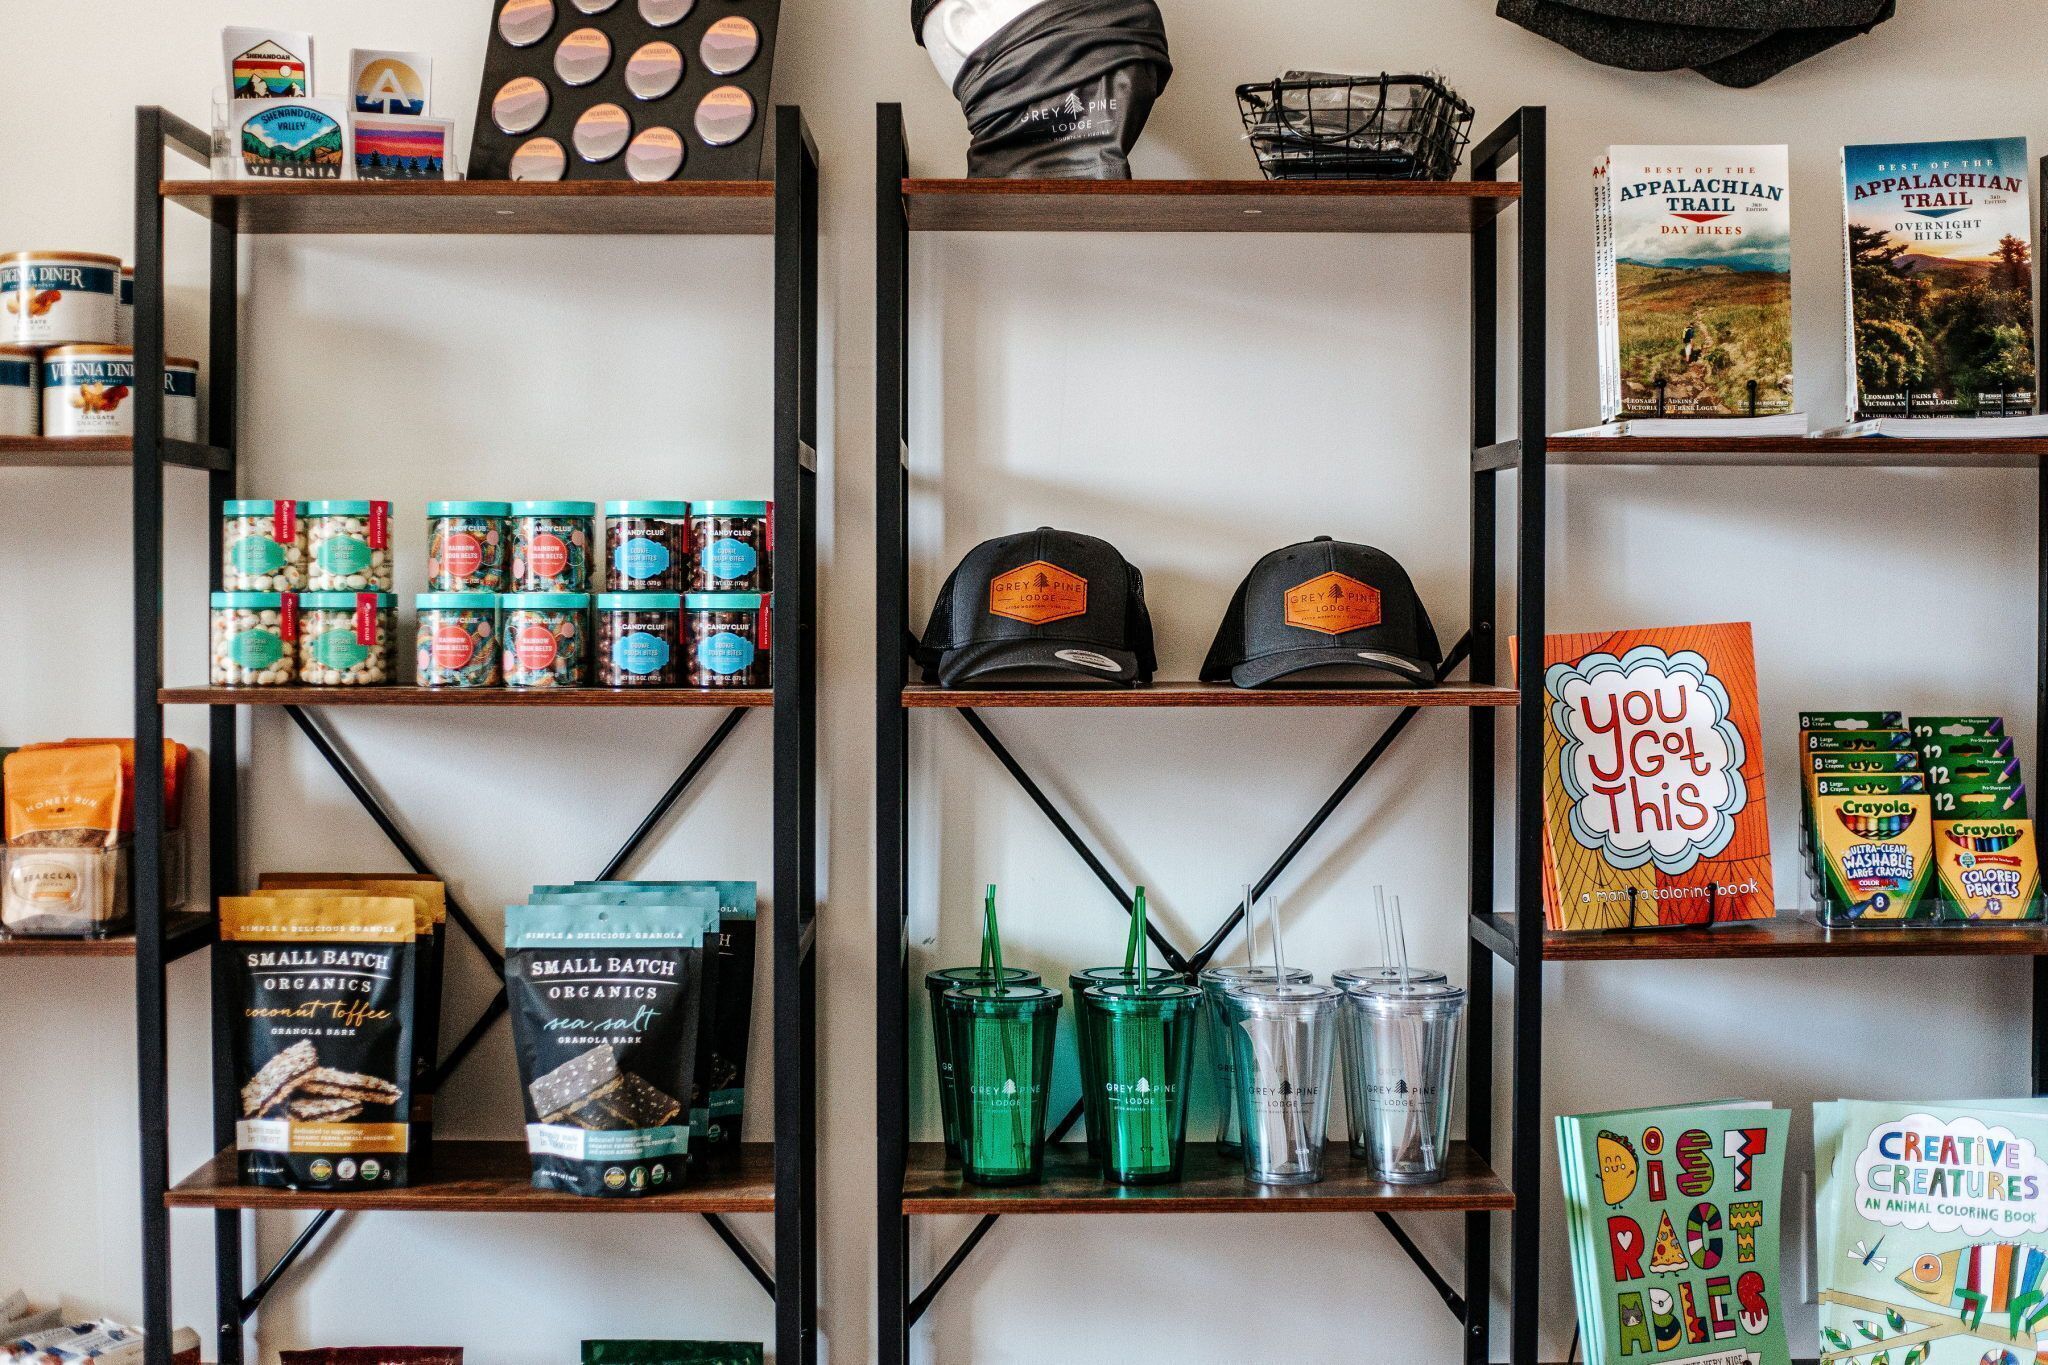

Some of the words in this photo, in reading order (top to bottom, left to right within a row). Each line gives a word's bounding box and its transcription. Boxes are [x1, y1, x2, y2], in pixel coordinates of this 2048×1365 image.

[1088, 99, 1117, 113] PINE
[261, 108, 323, 124] SHENANDOAH
[278, 122, 306, 131] VALLEY
[1052, 120, 1092, 132] LODGE
[1962, 160, 1994, 168] THE
[251, 165, 337, 178] VIRGINIA
[1620, 179, 1784, 202] APPALACHIAN
[1854, 174, 2022, 200] APPALACHIAN
[1666, 198, 1735, 212] TRAIL
[1902, 192, 1973, 208] TRAIL
[1661, 226, 1688, 234] DAY
[1696, 226, 1742, 234] HIKES
[1895, 220, 1982, 231] OVERNIGHT
[1914, 231, 1962, 240] HIKES
[40, 267, 85, 288] DINER
[107, 363, 134, 376] DIN
[996, 582, 1030, 592] GREY
[1054, 582, 1081, 592] PINE
[1290, 592, 1324, 604] GREY
[1348, 592, 1376, 604] PINE
[1802, 716, 1810, 727] 8
[1810, 737, 1818, 748] 8
[1630, 727, 1711, 777] Got
[1815, 758, 1822, 770] 8
[1930, 766, 1950, 784] 12
[1820, 782, 1828, 793] 8
[26, 796, 70, 814] HONEY
[1843, 800, 1910, 816] Crayola
[1935, 792, 1956, 811] 12
[1952, 824, 2016, 837] Crayola
[1850, 844, 1906, 855] ULTRA-CLEAN
[1842, 852, 1913, 869] WASHABLE
[1847, 868, 1874, 879] LARGE
[1876, 866, 1913, 879] CRAYONS
[1961, 869, 2020, 883] COLORED
[1582, 893, 1590, 903] a
[1596, 885, 1648, 902] manta
[1716, 878, 1758, 895] book
[1966, 882, 2019, 898] PENCILS
[1876, 896, 1884, 908] 8
[1989, 900, 2000, 910] 12
[248, 951, 317, 967] SMALL
[322, 950, 389, 970] BATCH
[531, 958, 601, 976] SMALL
[608, 957, 676, 976] BATCH
[264, 978, 371, 992] ORGANICS
[549, 987, 657, 999] ORGANICS
[246, 1000, 325, 1018] coconut
[324, 1000, 391, 1027] toffee
[543, 1015, 594, 1031] sea
[594, 1004, 662, 1033] salt
[970, 1085, 1000, 1095] GREY
[1106, 1083, 1133, 1093] GREY
[1153, 1084, 1176, 1093] PINE
[1249, 1087, 1275, 1096] GREY
[1296, 1087, 1318, 1096] PINE
[1367, 1085, 1391, 1094] GREY
[1412, 1086, 1435, 1095] PINE
[1868, 1164, 2039, 1201] CREATURES
[1865, 1198, 1880, 1210] AN
[2004, 1210, 2037, 1223] BOOK
[1607, 1200, 1763, 1282] RACT
[1618, 1270, 1769, 1356] ABLES
